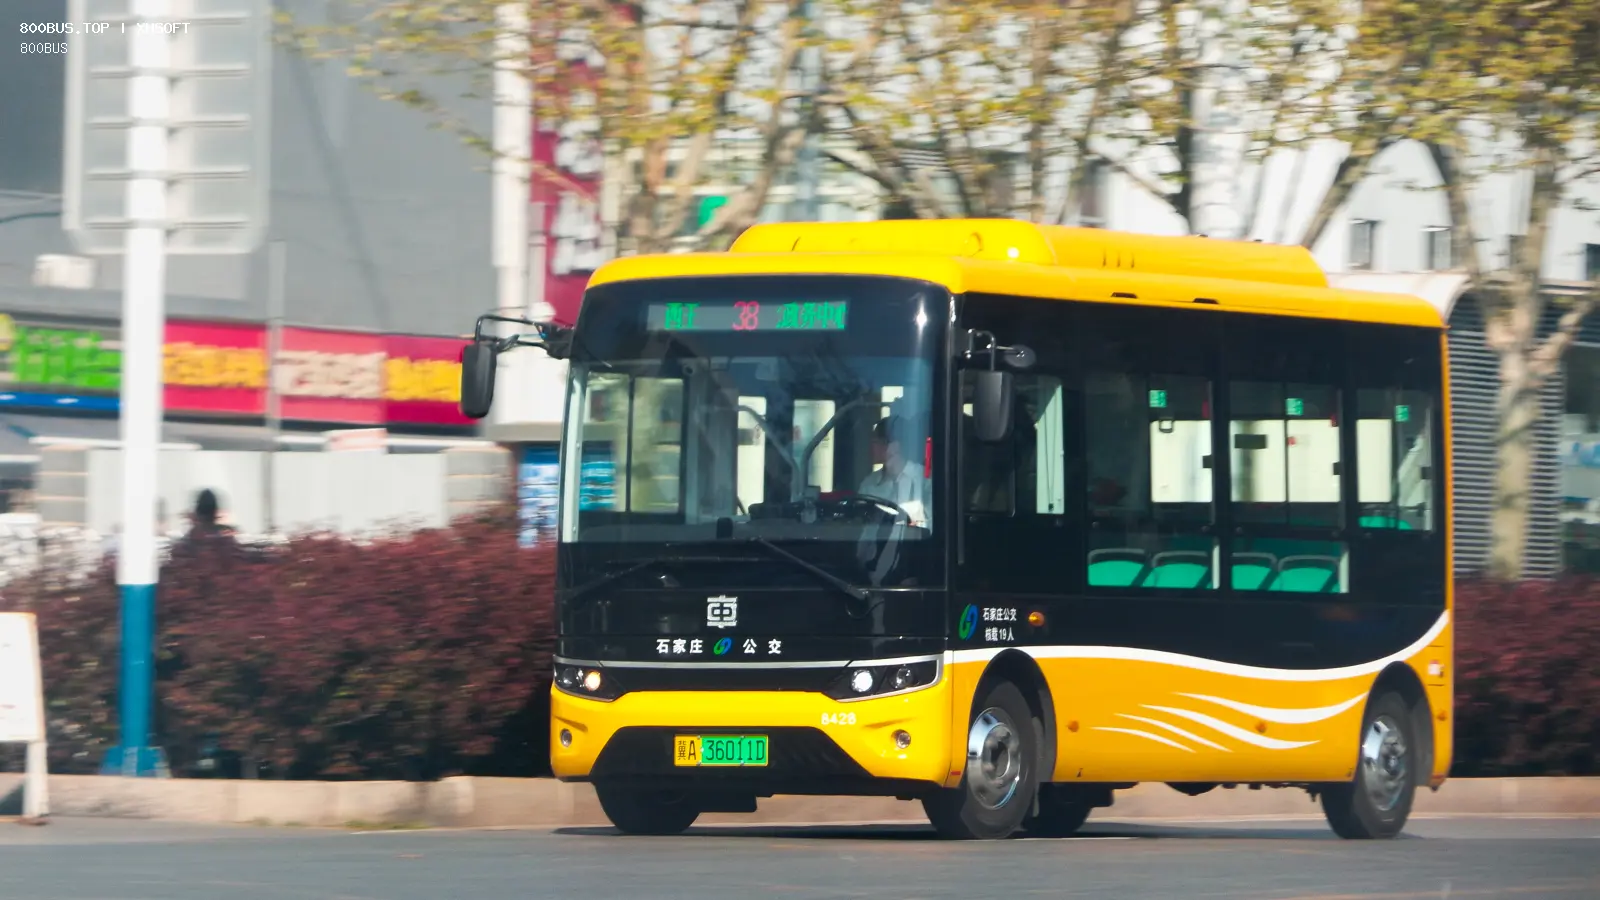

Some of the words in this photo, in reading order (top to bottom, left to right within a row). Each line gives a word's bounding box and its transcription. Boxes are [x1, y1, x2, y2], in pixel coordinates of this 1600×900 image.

[732, 300, 760, 331] 38
[982, 607, 1017, 622] 石家庄公交
[655, 638, 704, 654] 石家庄
[821, 712, 857, 726] 8428
